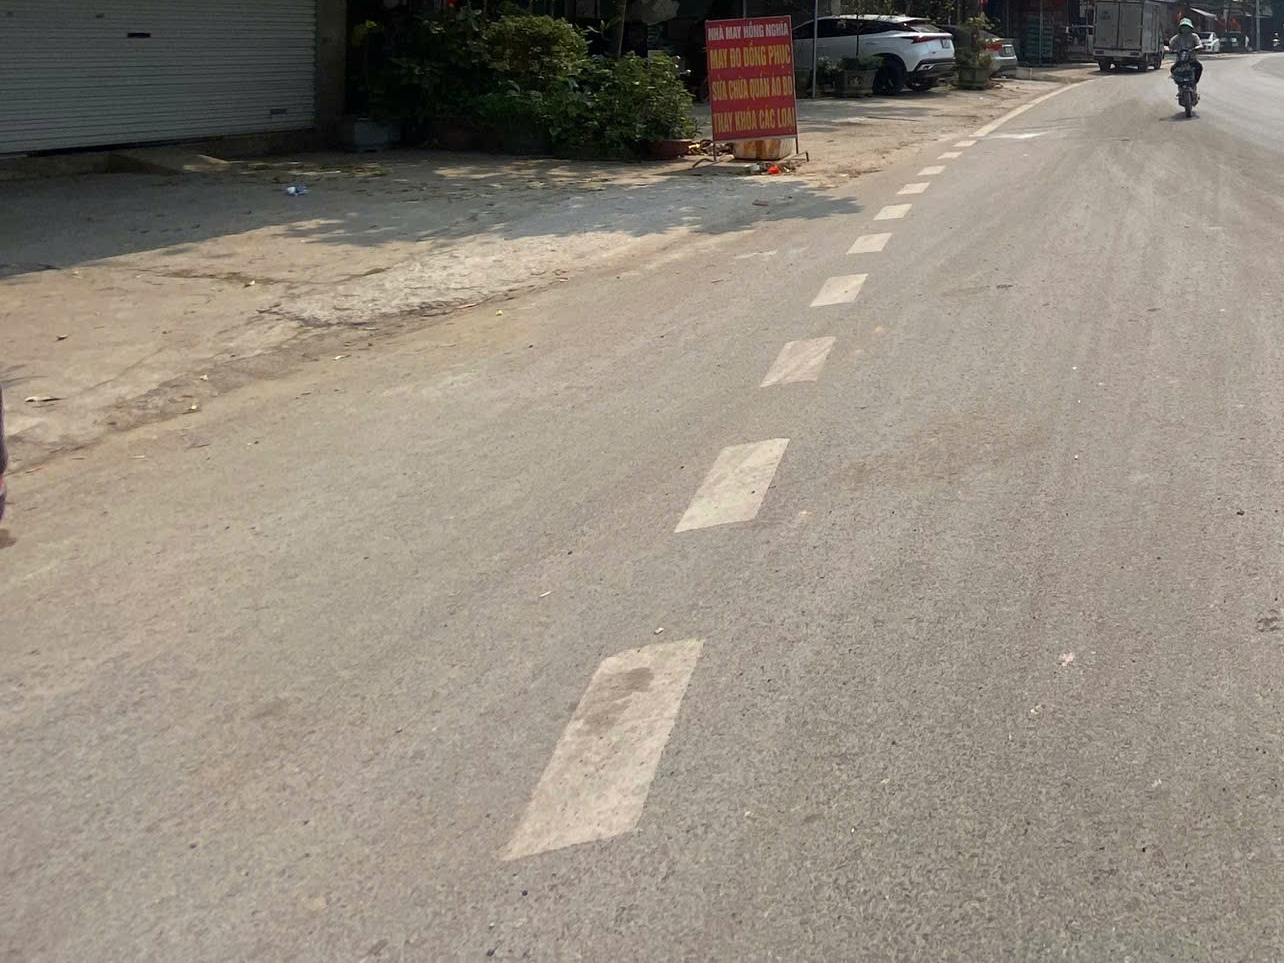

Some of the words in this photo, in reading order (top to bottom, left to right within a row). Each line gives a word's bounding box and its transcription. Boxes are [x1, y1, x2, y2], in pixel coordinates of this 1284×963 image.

[708, 24, 724, 41] NHÀ
[725, 26, 741, 39] MAY
[766, 21, 789, 37] NGHĨA
[710, 47, 728, 69] MAY
[744, 40, 766, 67] ĐỒNG
[768, 43, 791, 69] PHỤC
[729, 75, 748, 99] CHỮA
[749, 73, 770, 100] QUẦN
[771, 72, 781, 97] ÁO
[713, 112, 733, 134] THAY
[760, 104, 775, 130] CÁC
[778, 107, 795, 132] LOẠI
